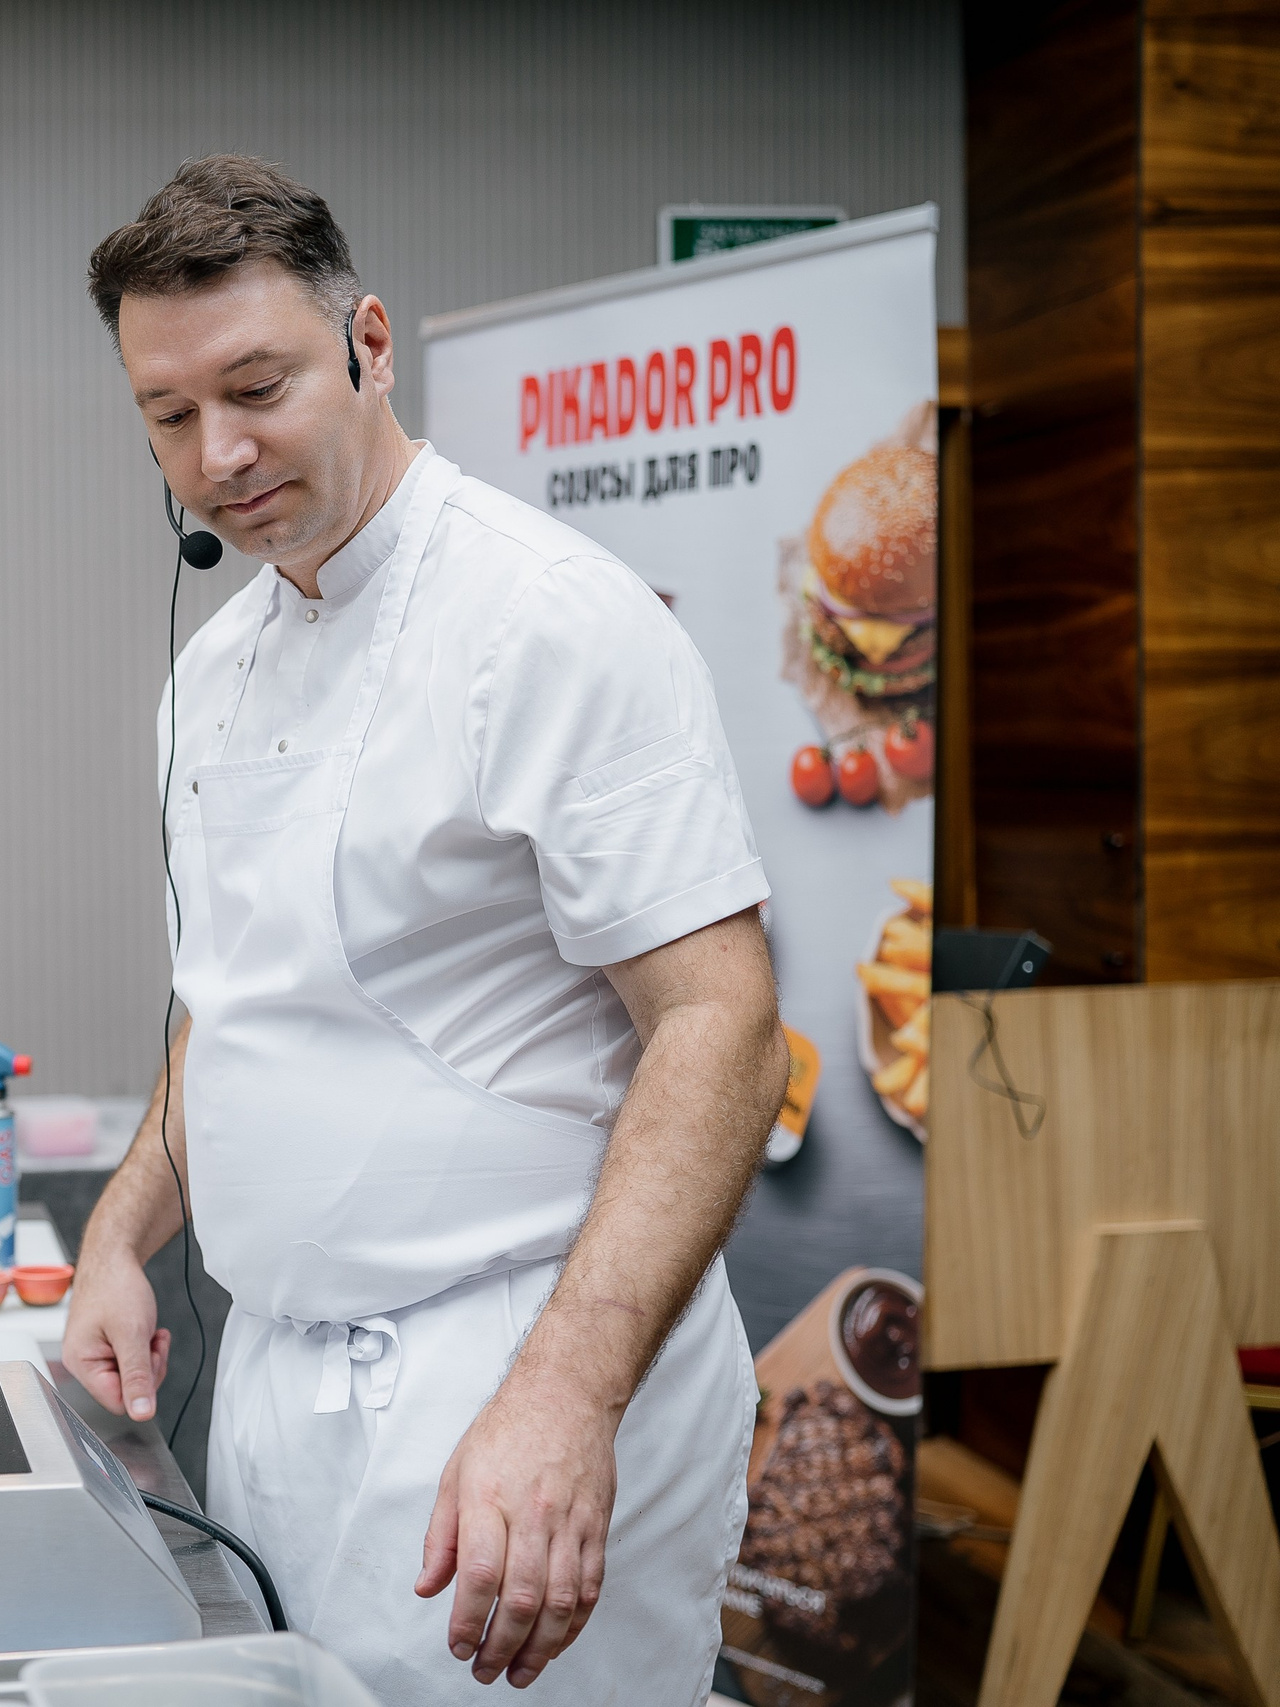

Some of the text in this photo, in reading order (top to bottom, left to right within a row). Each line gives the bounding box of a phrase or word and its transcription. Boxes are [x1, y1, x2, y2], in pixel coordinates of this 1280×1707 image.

[520, 325, 797, 453] PIKADOR PRO
[548, 444, 760, 507] СОУСЫ ДЛЯ ПРО
